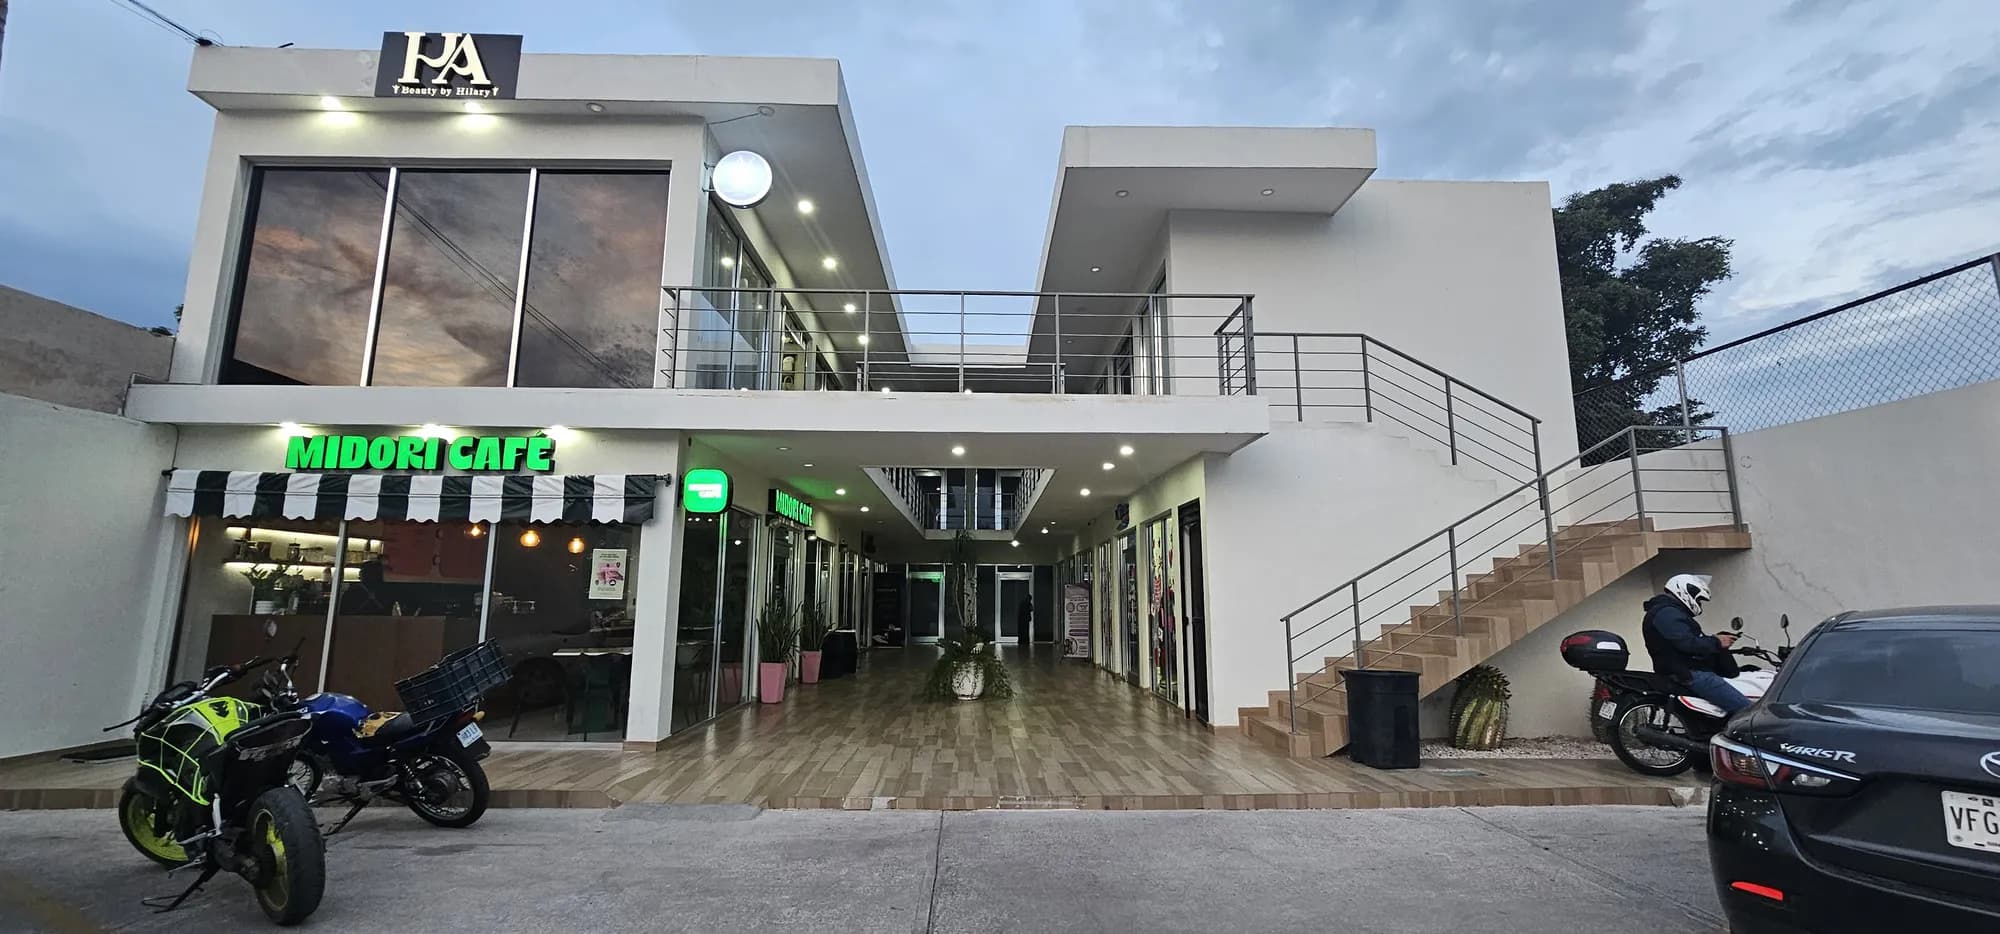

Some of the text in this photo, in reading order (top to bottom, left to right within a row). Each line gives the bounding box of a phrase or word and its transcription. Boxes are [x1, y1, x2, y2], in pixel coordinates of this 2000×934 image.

[401, 86, 491, 98] Beauty by Hilary
[285, 435, 440, 470] MIDORI
[776, 489, 799, 521] MIDORI
